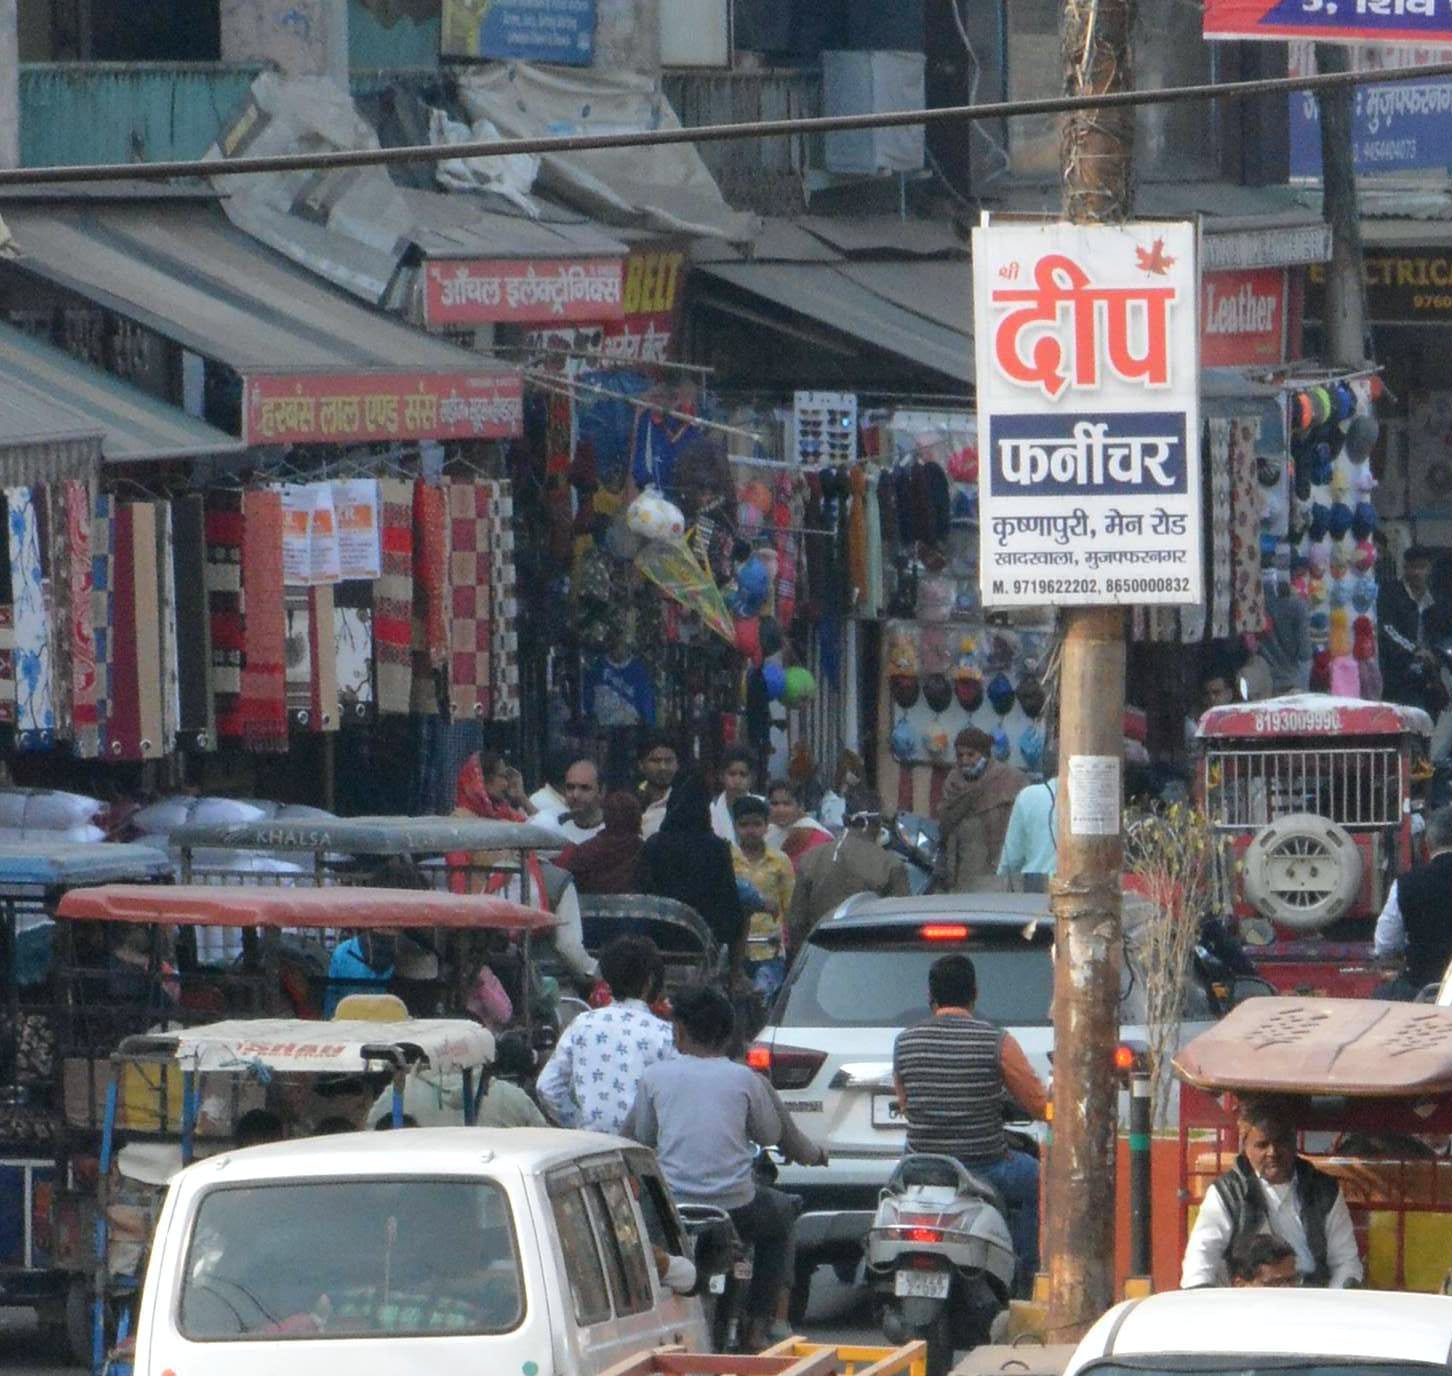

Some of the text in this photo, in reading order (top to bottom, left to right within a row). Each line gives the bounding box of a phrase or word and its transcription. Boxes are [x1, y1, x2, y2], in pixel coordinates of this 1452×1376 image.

[992, 254, 1176, 397] दीप
[1205, 278, 1277, 335] Leather
[998, 420, 1179, 486] फर्नीचर
[992, 507, 1189, 547] कृष्णापुरी, मेन रोड
[1084, 549, 1187, 570] मुजफ्फरनगर
[992, 576, 1190, 595] M. 9719622202, 8650000832
[256, 829, 332, 847] KHALSA
